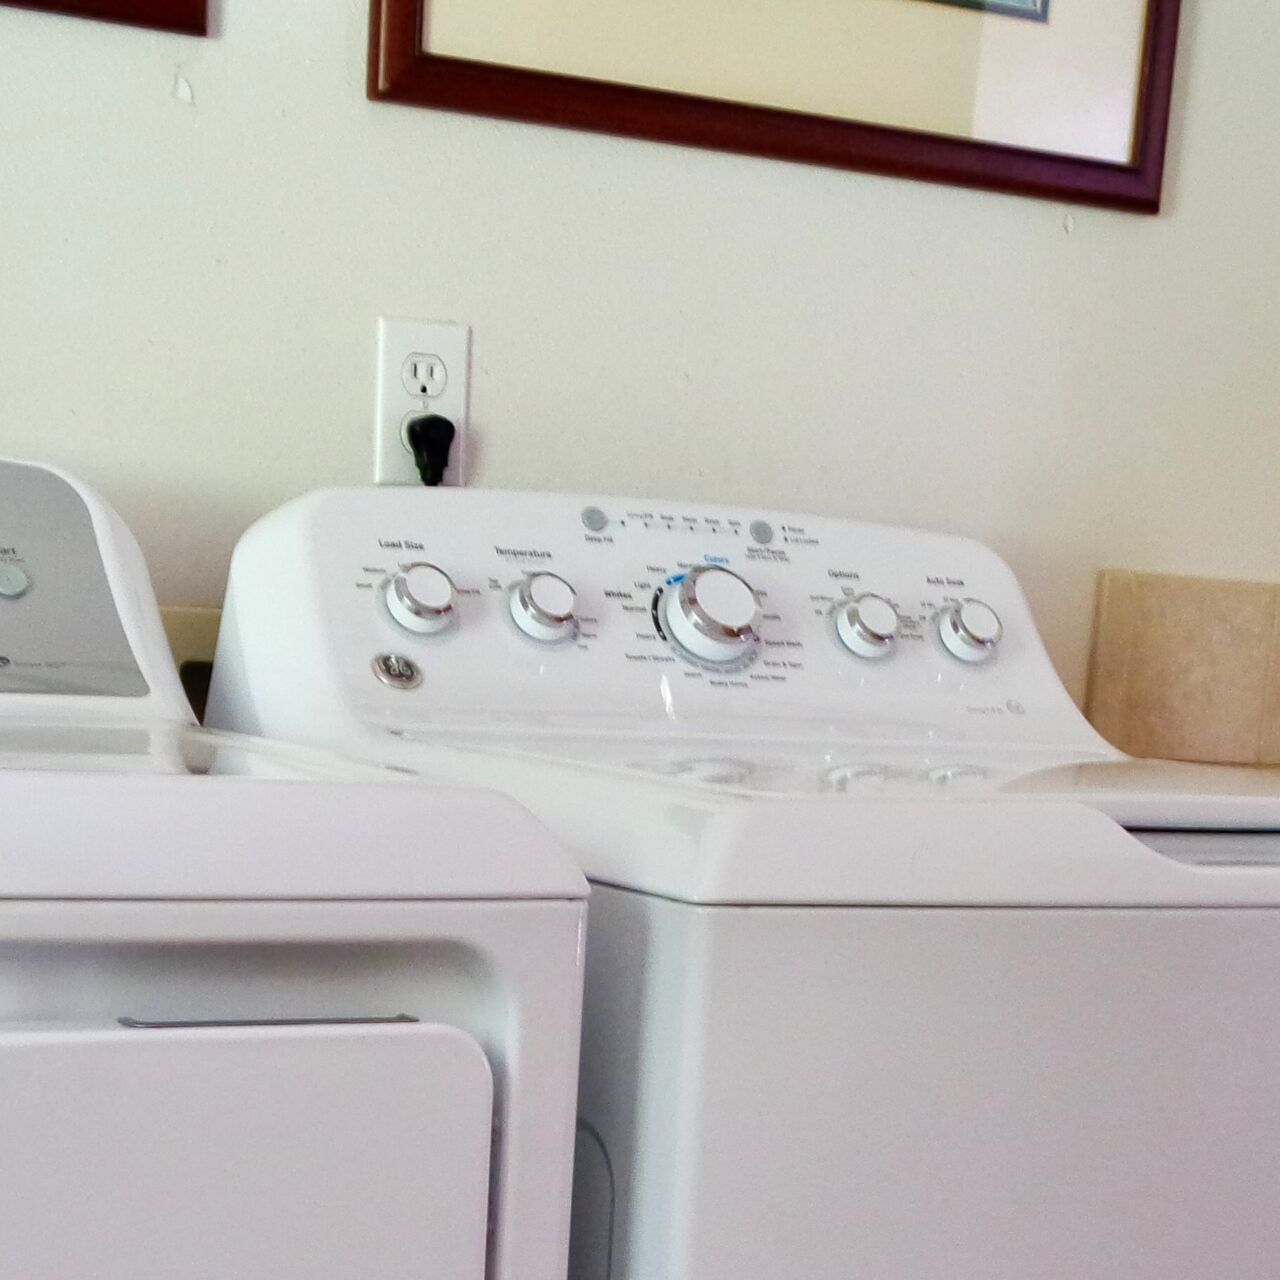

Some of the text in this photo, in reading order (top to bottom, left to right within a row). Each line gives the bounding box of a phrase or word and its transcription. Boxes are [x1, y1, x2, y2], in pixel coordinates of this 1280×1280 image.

[378, 538, 425, 551] Load Size
[494, 546, 552, 559] Temperature
[827, 568, 860, 581] Options
